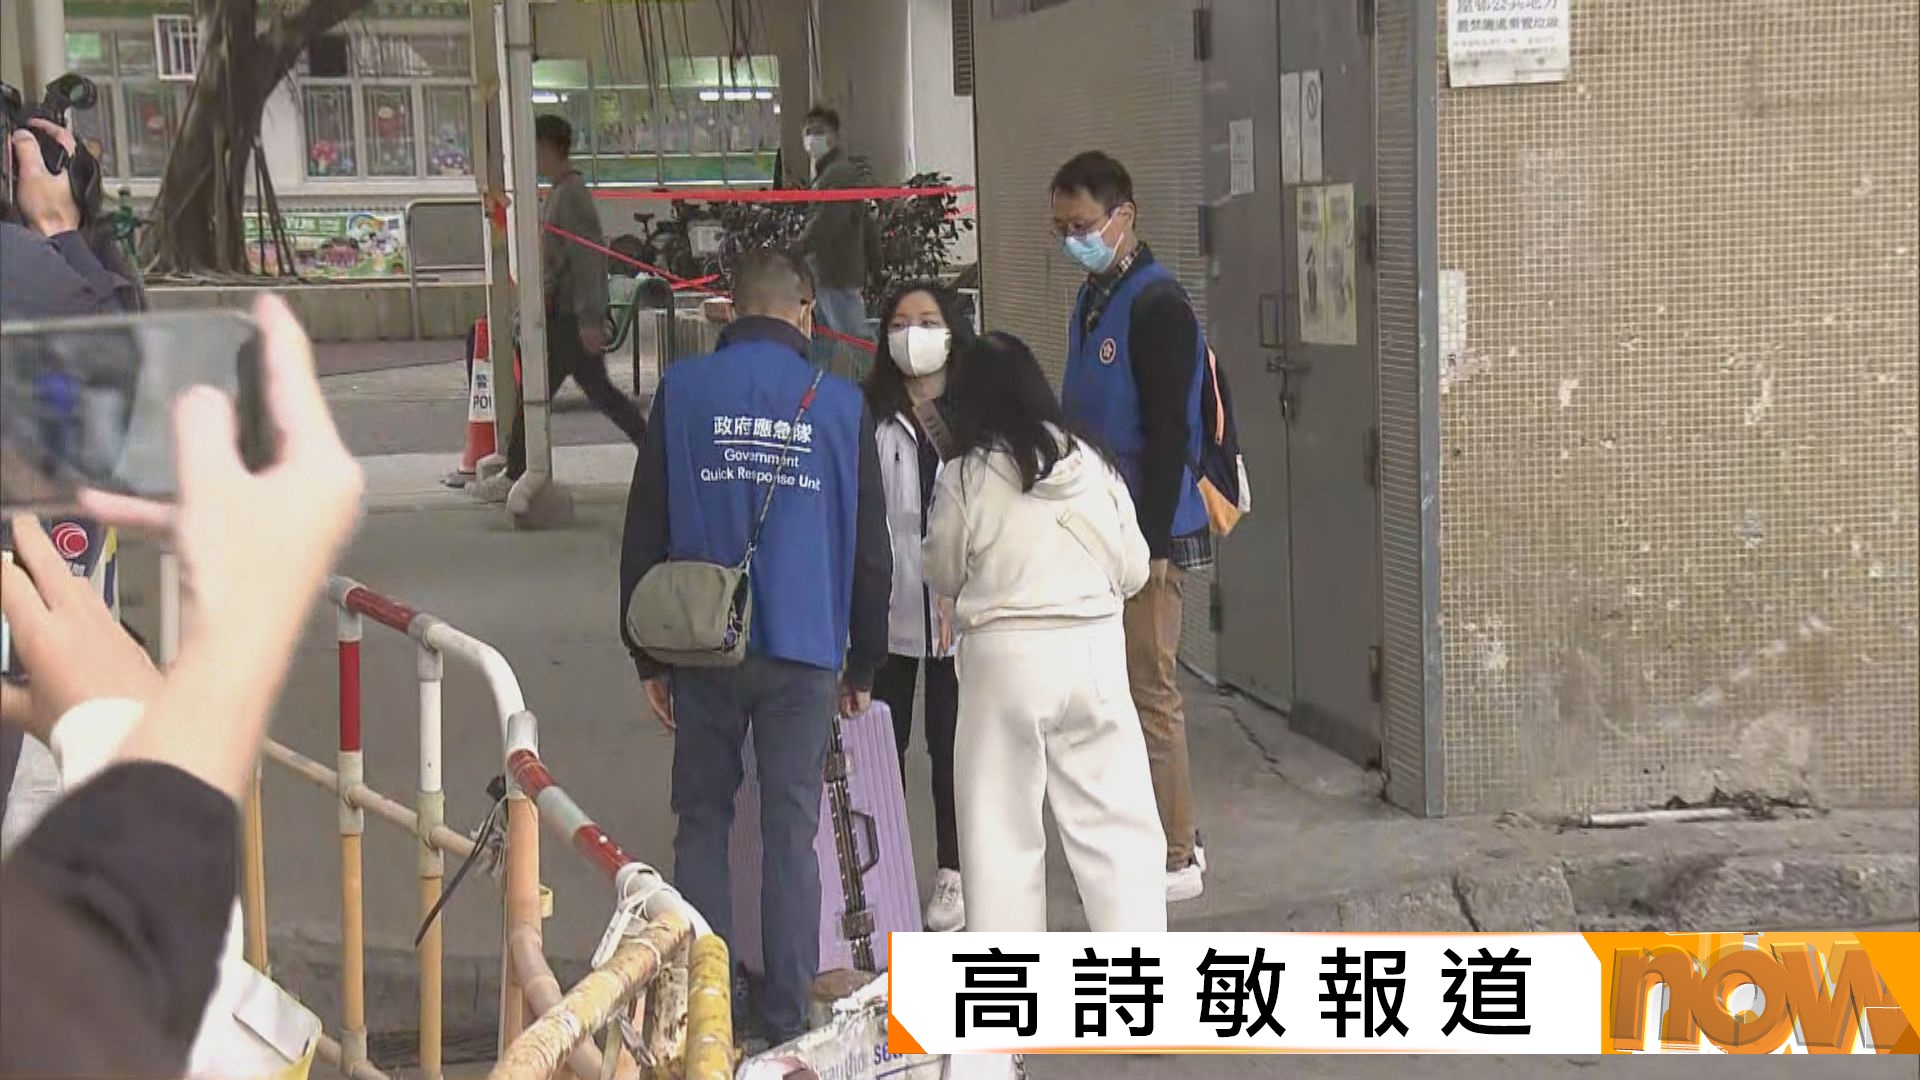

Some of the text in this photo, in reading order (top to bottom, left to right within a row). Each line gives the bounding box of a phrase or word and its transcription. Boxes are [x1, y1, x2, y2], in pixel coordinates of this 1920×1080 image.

[713, 416, 812, 443] 政府應急隊
[700, 467, 735, 482] Quick
